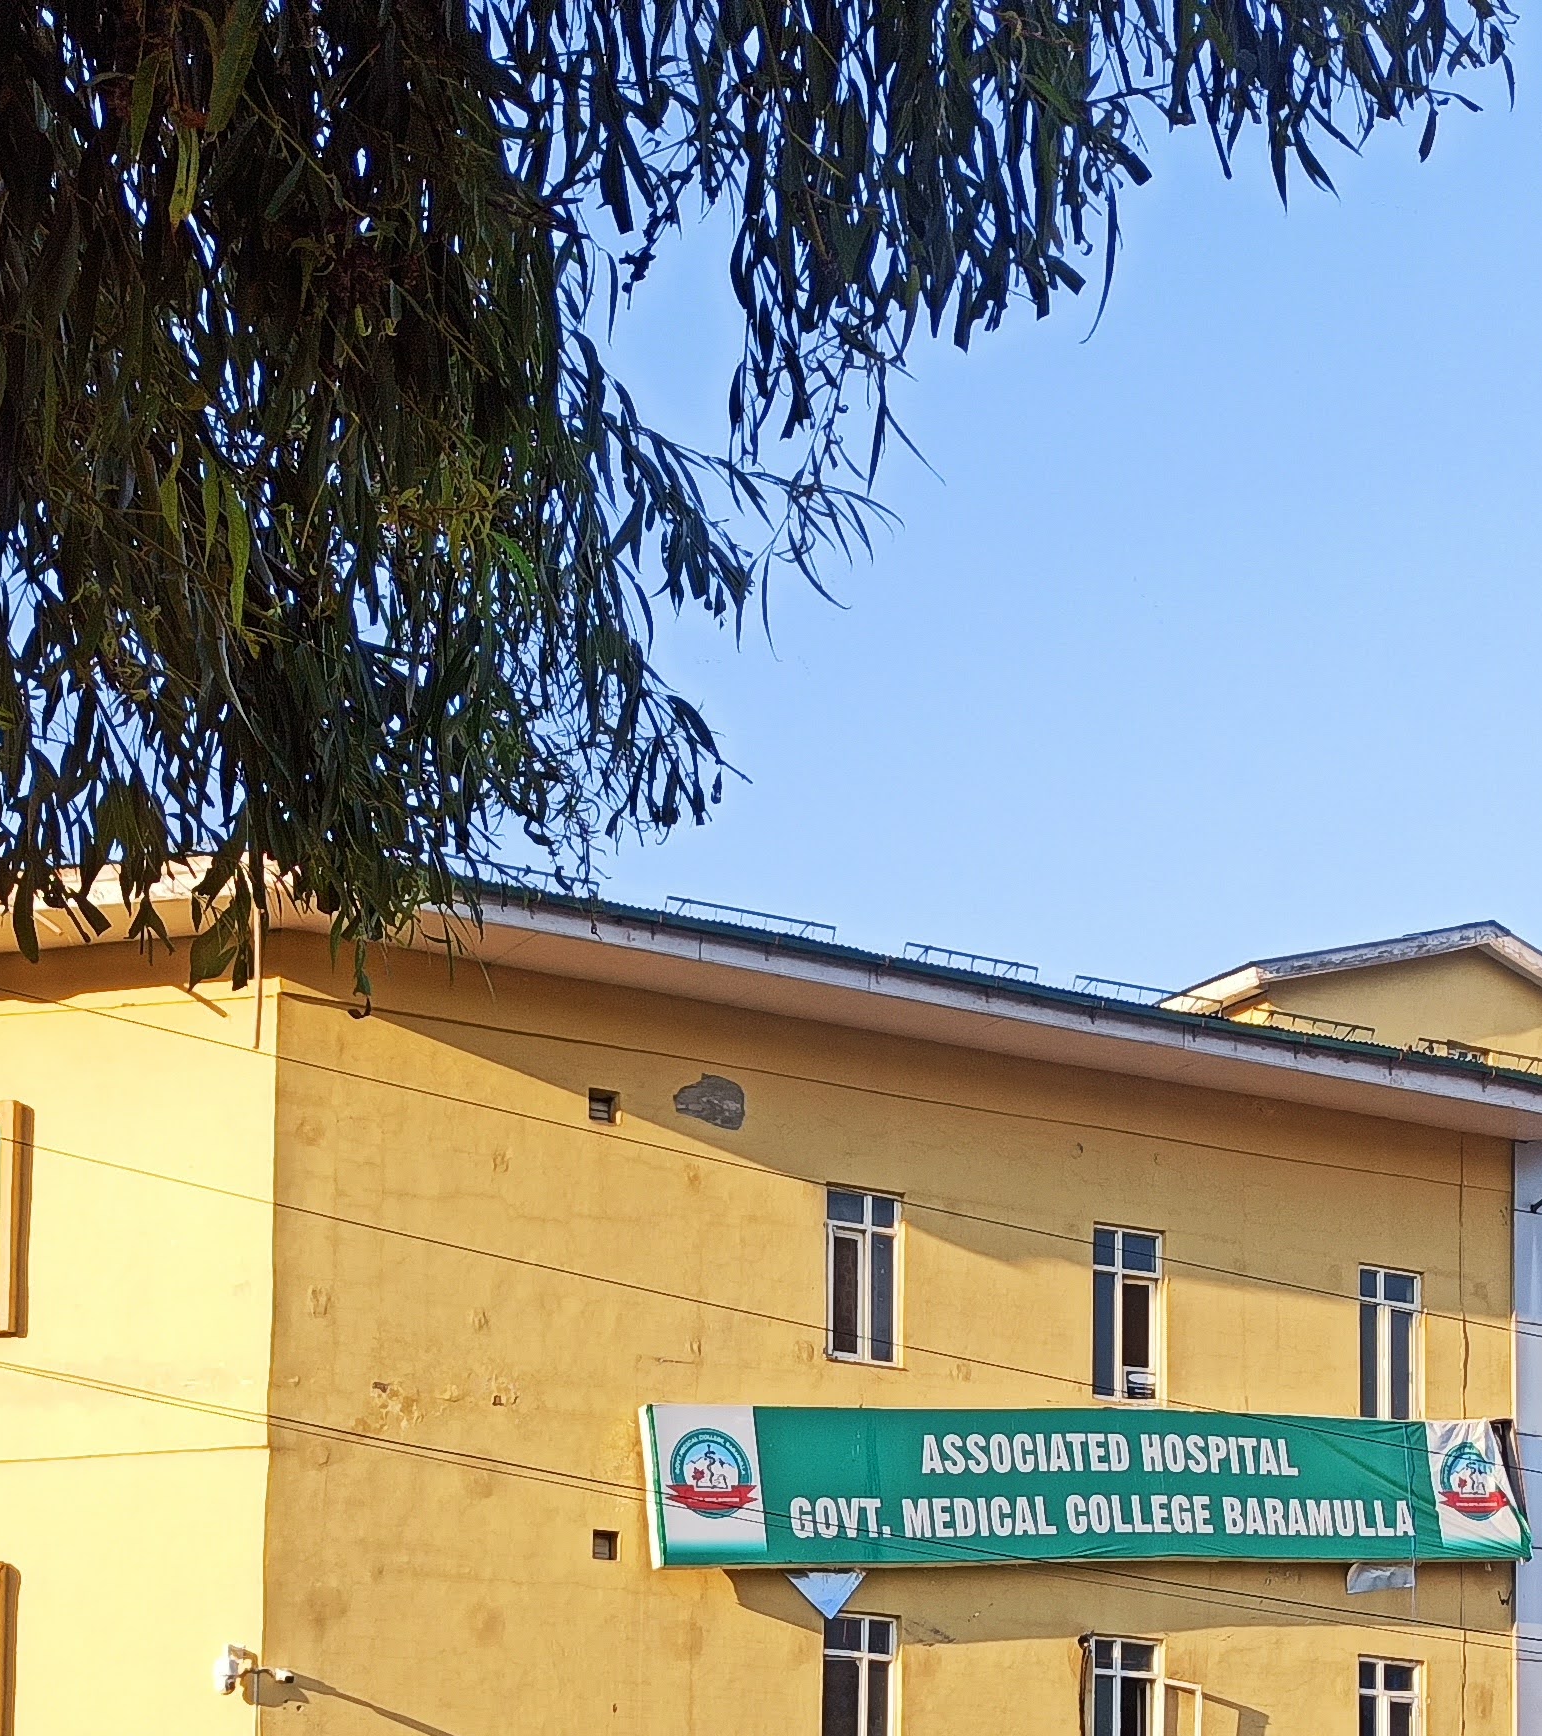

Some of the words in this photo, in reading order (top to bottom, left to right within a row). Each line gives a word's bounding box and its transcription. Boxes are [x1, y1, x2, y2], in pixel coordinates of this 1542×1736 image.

[921, 1433, 1130, 1475] ASSOCIATED
[1140, 1433, 1300, 1476] HOSPITAL
[790, 1496, 892, 1539] GOVT.
[902, 1495, 1057, 1538] MEDICAL
[1065, 1494, 1214, 1535] COLLEGE
[1222, 1496, 1416, 1537] BARAMULLA
